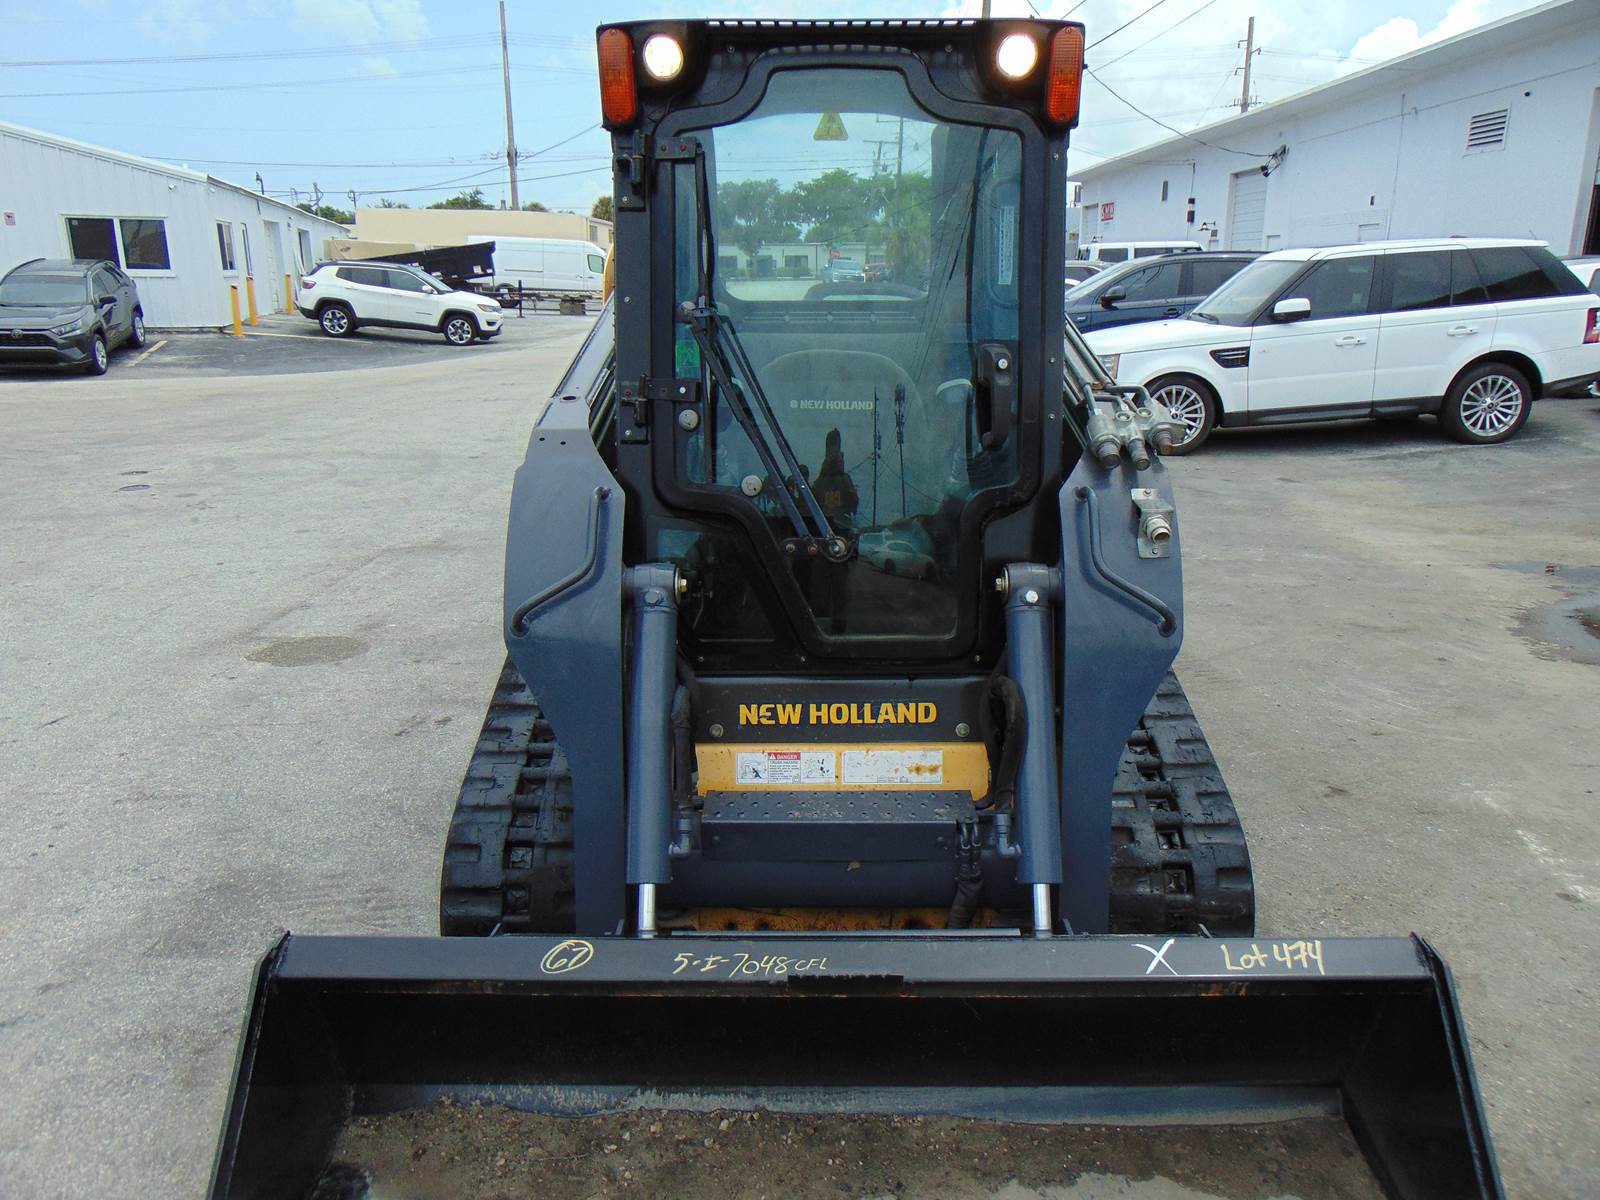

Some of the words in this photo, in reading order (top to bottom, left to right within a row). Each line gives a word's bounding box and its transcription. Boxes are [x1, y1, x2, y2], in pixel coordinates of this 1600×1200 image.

[800, 399, 825, 410] NEW
[826, 399, 874, 410] HOLLAND
[739, 703, 802, 726] NEW
[809, 702, 938, 725] HOLLAND
[545, 942, 590, 970] 67
[1130, 938, 1179, 976] X
[1219, 942, 1268, 971] Lot
[1272, 939, 1326, 976] 474
